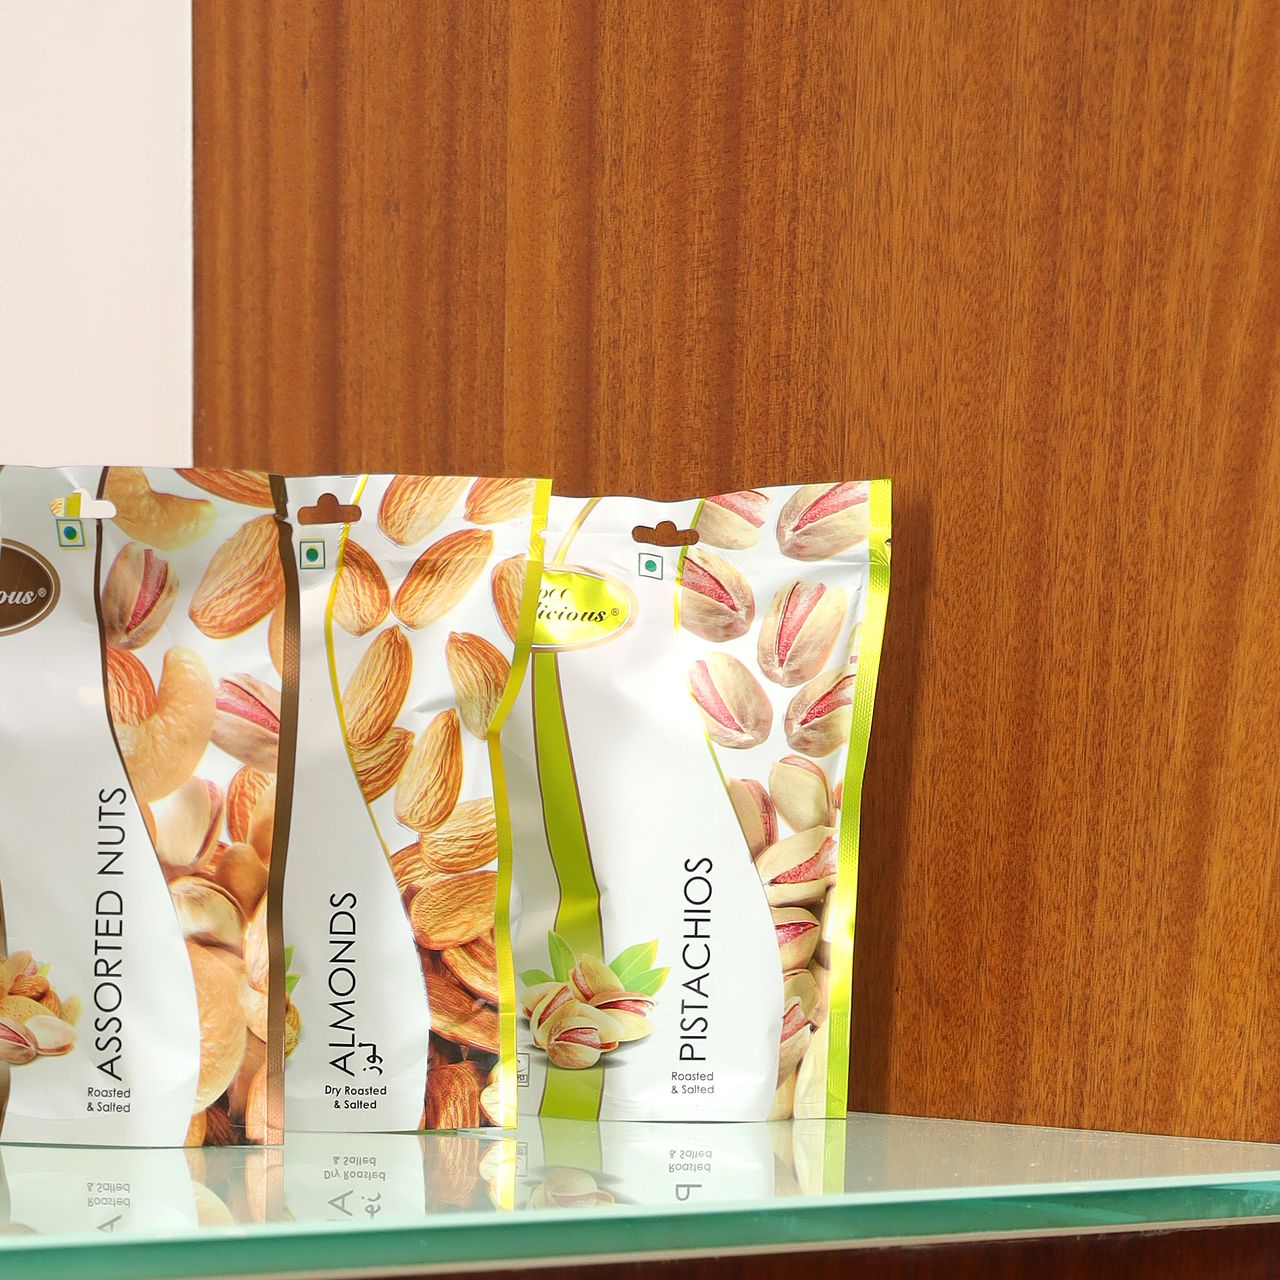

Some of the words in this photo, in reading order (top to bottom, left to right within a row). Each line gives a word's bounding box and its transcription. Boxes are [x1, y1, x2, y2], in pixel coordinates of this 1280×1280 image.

[96, 788, 127, 875] NUTS
[679, 857, 713, 1061] PISTACHIOS
[93, 890, 124, 1081] ASSORTED
[328, 892, 357, 1077] ALMONDS
[671, 1071, 714, 1082] Roasted
[87, 1087, 131, 1099] Roasted
[324, 1085, 342, 1097] Dry
[344, 1085, 387, 1096] Roasted
[671, 1085, 679, 1094] &
[681, 1084, 715, 1095] Salted
[87, 1102, 95, 1112] &
[96, 1101, 131, 1113] Salted
[333, 1100, 342, 1109] &
[344, 1099, 377, 1110] Salted
